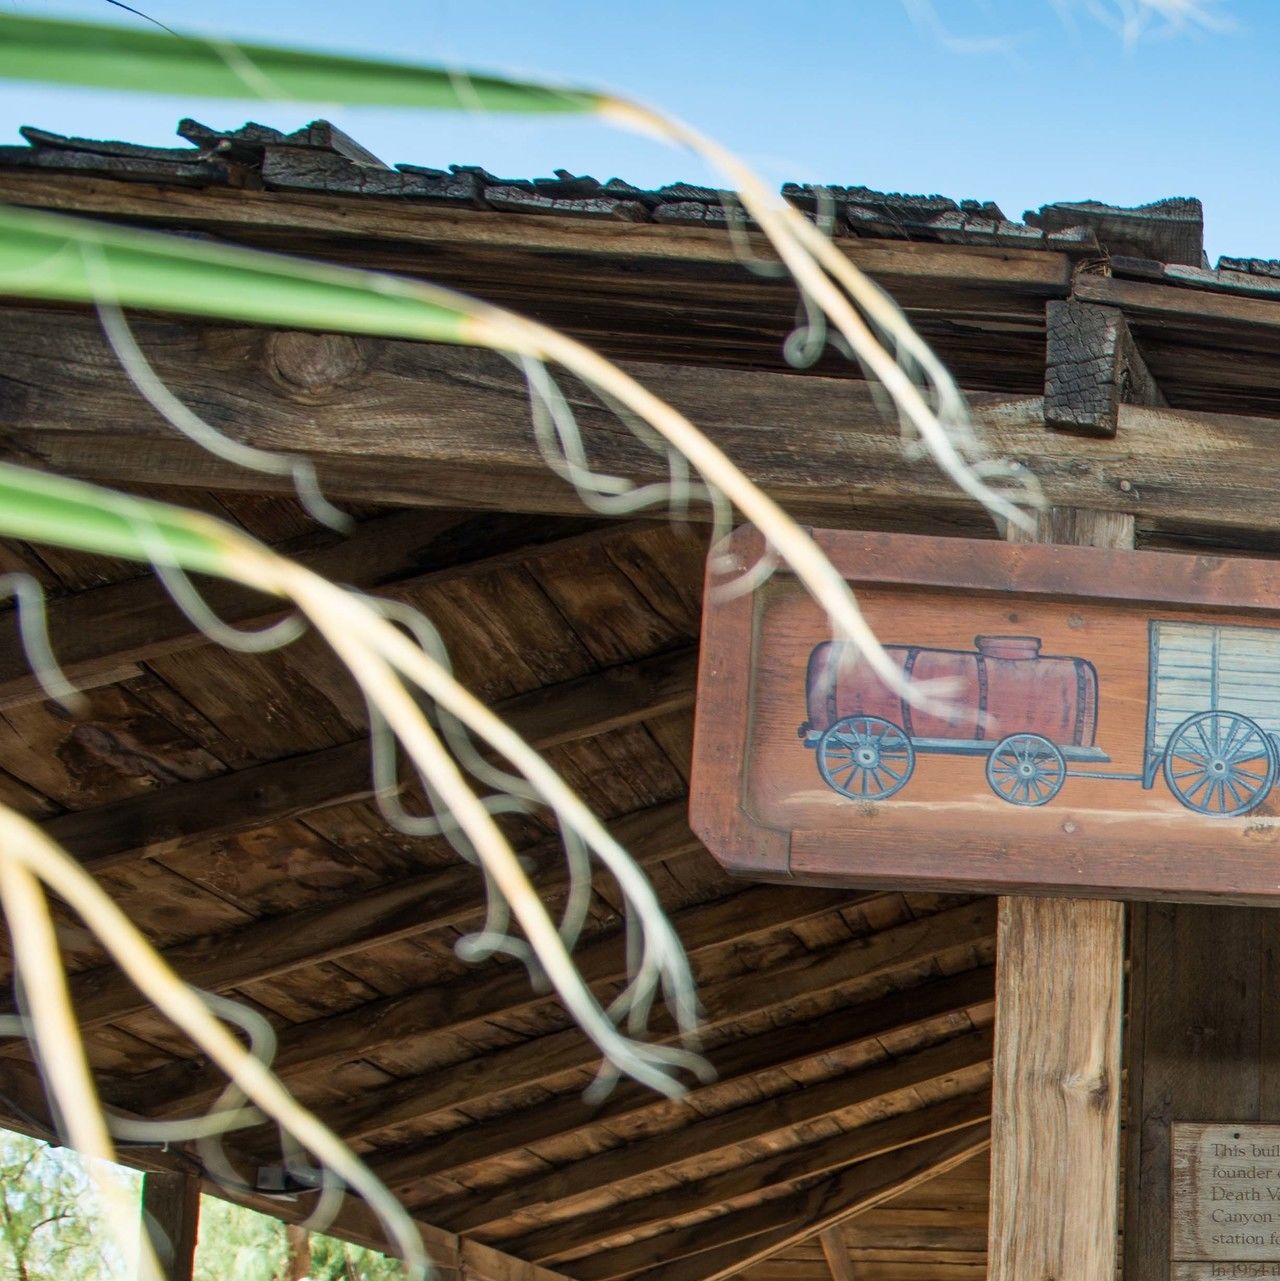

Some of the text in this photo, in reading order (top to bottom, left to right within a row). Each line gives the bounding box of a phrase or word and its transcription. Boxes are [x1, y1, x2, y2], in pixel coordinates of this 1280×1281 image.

[1211, 1143, 1246, 1158] This
[1211, 1166, 1273, 1180] founder
[1211, 1187, 1260, 1201] Death
[1211, 1209, 1272, 1226] Canyon
[1211, 1234, 1265, 1245] station
[1211, 1262, 1227, 1276] In
[1232, 1262, 1270, 1276] 1954
